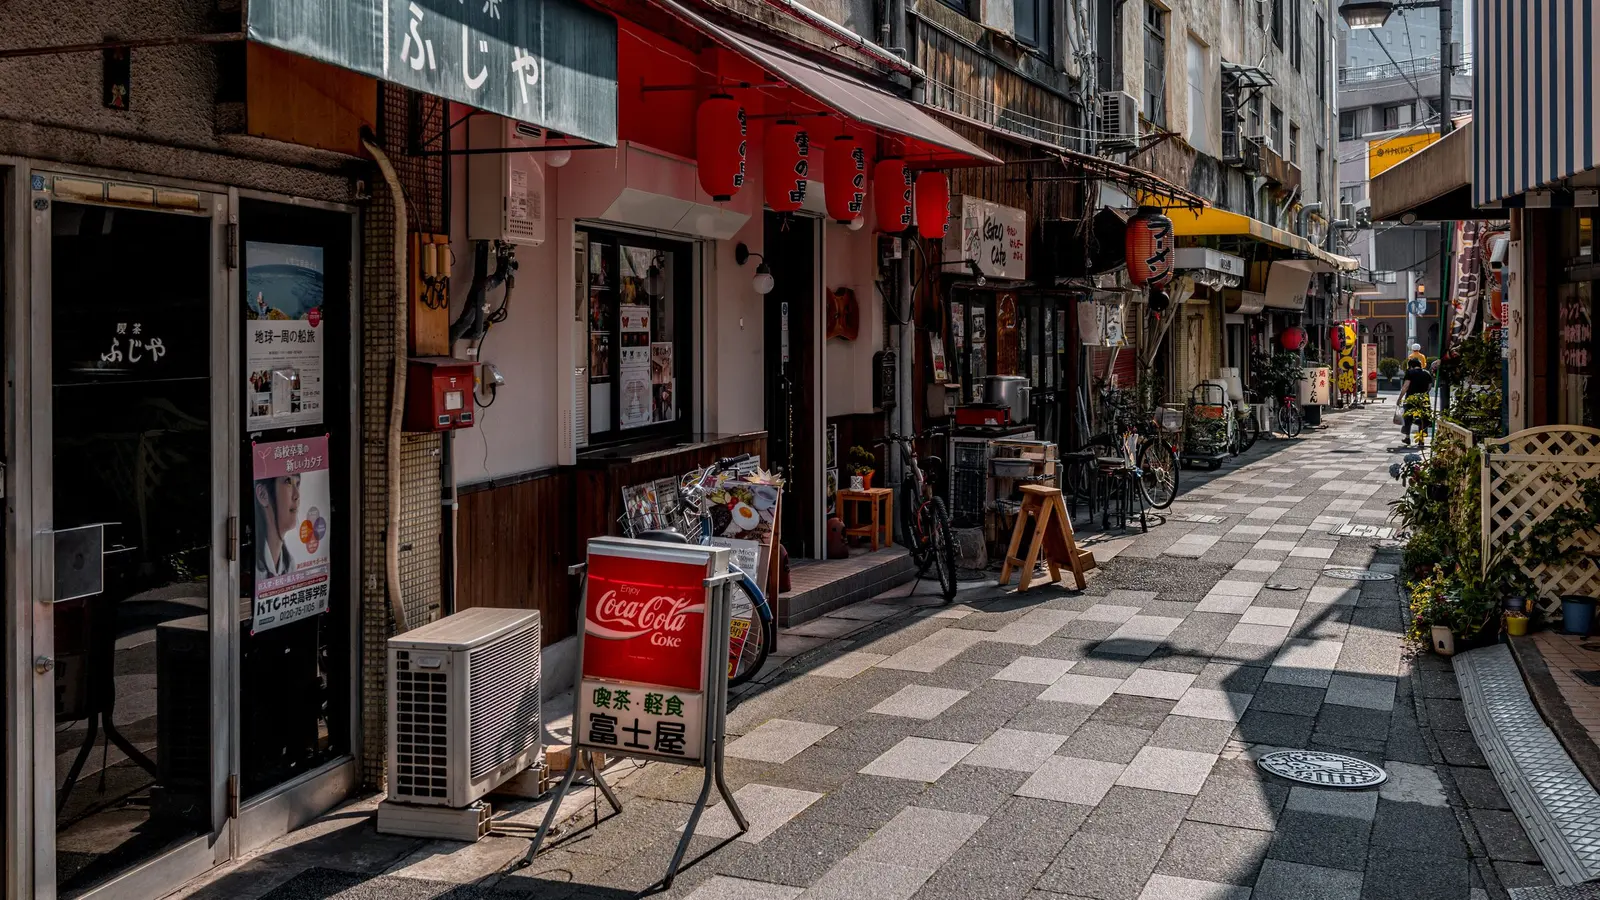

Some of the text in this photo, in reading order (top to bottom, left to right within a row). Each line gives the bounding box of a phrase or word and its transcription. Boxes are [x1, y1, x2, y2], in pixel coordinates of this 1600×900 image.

[400, 2, 539, 104] ふじや
[991, 243, 1006, 266] Cafe
[116, 322, 142, 335] 喫茶
[255, 329, 316, 343] 地球一周の船旅
[100, 337, 166, 363] ふじや
[1309, 371, 1318, 403] ひょうたん
[273, 444, 309, 459] 高校卒業の
[286, 456, 323, 473] 新しいカタチ
[620, 584, 641, 596] Enjoy
[595, 589, 692, 632] Coca-Cola
[650, 631, 682, 648] Coke
[592, 687, 685, 717] 喫茶・軽食
[589, 713, 686, 755] 富士屋
